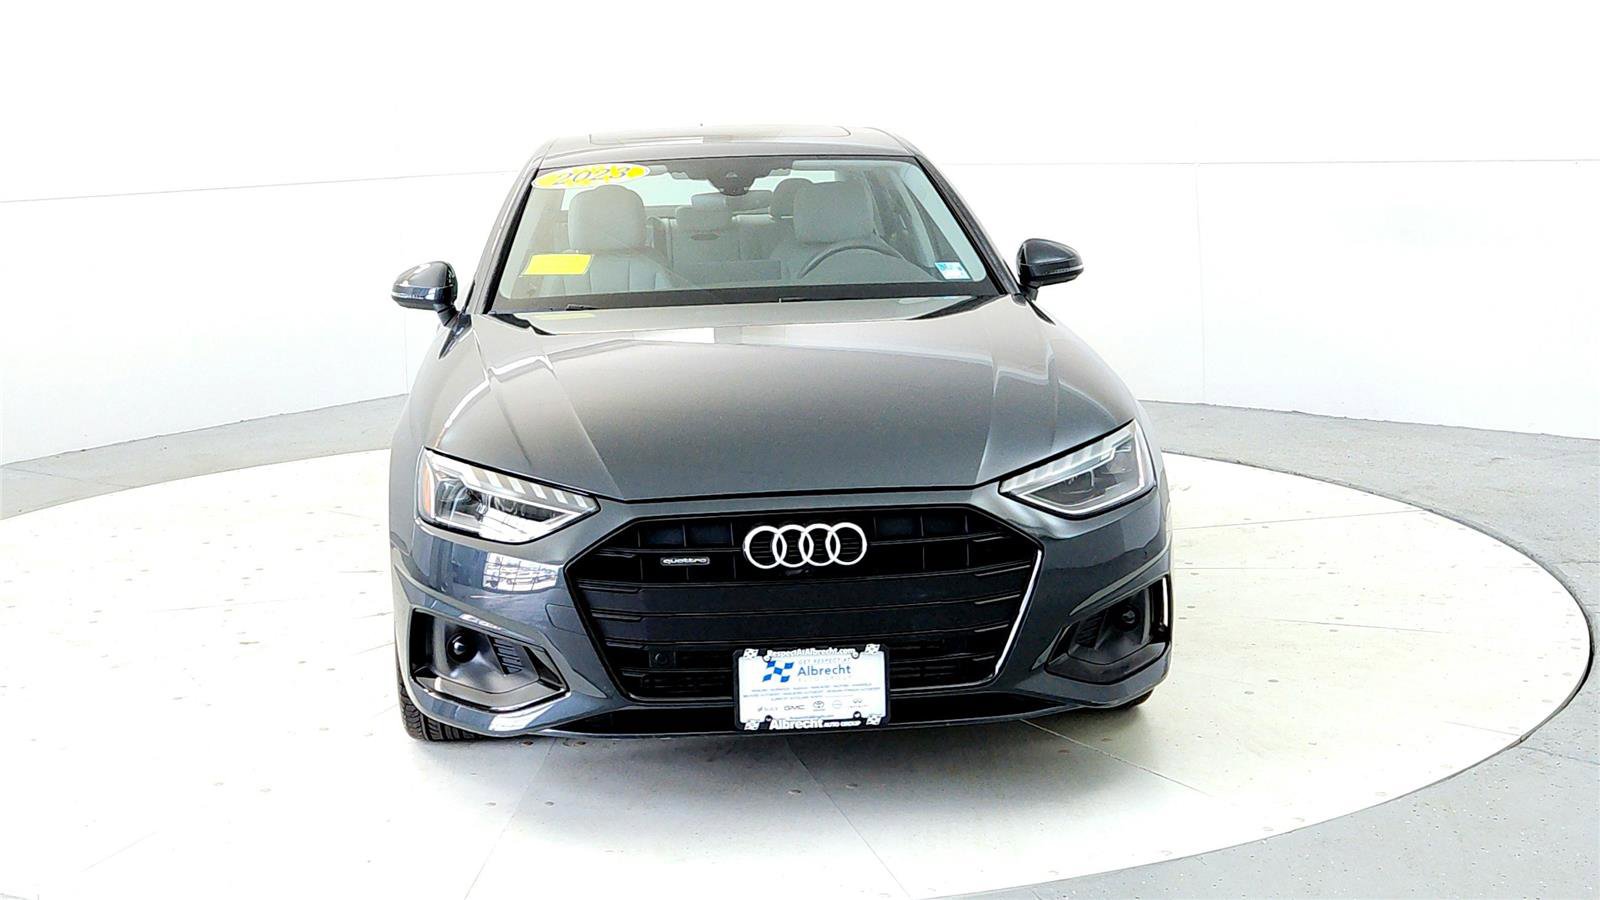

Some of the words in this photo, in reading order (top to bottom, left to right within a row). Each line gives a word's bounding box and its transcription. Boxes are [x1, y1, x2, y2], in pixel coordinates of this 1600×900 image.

[551, 167, 630, 185] 2023
[798, 665, 851, 676] Albrecht
[769, 719, 823, 730] Albrecht
